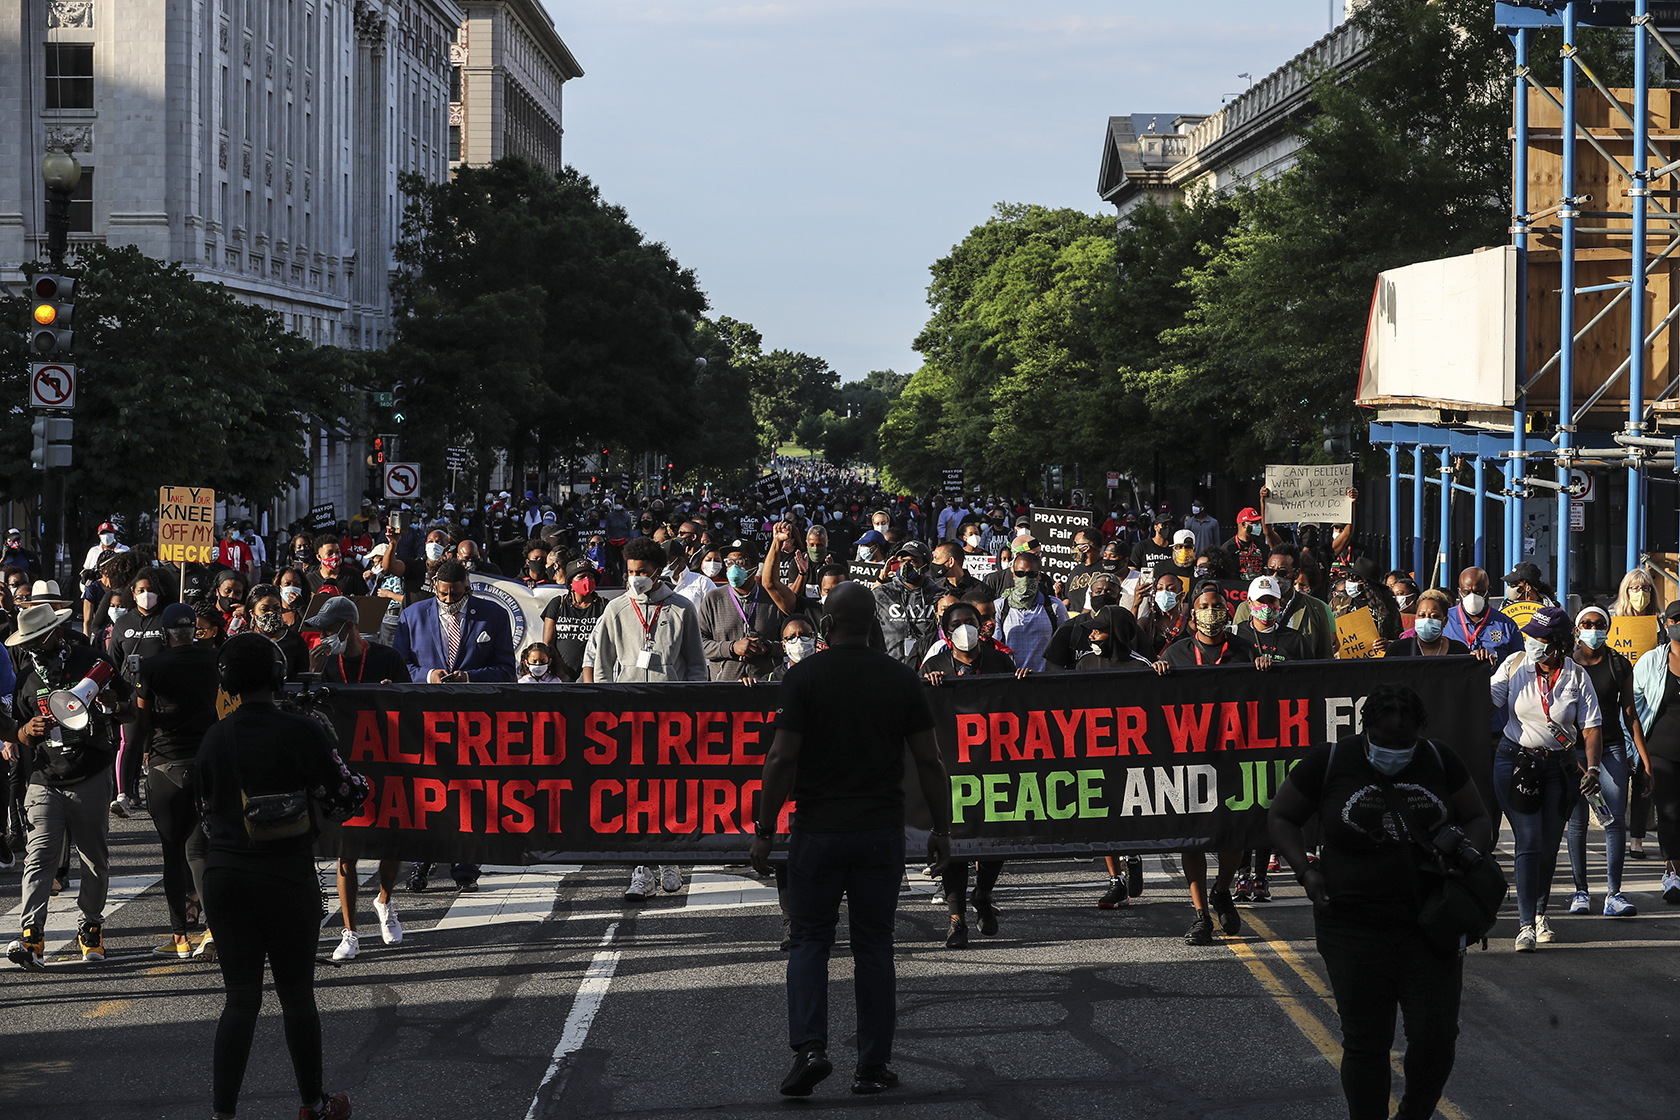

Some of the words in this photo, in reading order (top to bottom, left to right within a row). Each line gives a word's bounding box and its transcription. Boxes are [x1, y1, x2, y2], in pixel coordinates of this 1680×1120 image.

[1313, 466, 1350, 477] BELIEVE
[1271, 478, 1301, 488] WHAT
[1307, 478, 1324, 487] YOU
[1328, 477, 1345, 486] SAY
[189, 488, 211, 505] YOUR
[1271, 488, 1316, 500] BECAUSE
[1320, 487, 1328, 497] I
[1332, 486, 1349, 497] SEE
[312, 506, 324, 514] PRAY
[1280, 500, 1307, 511] WHAT
[1308, 500, 1325, 509] YOU
[161, 503, 212, 523] KNEE
[315, 512, 331, 520] Godly
[1034, 513, 1065, 524] PRAY
[1066, 516, 1089, 527] FOR
[162, 523, 189, 541] OFF
[192, 525, 214, 542] MY
[1049, 528, 1073, 539] Fair
[160, 543, 211, 563] NECK
[1040, 543, 1071, 555] reatm
[850, 565, 878, 576] PRAY
[965, 563, 992, 571] IVES
[483, 586, 520, 613] ADVANCEMENT
[515, 615, 524, 623] OF
[1507, 606, 1519, 615] FOR
[1520, 604, 1532, 612] THE
[580, 616, 597, 626] QUI
[555, 624, 579, 632] WON'T
[1339, 626, 1344, 635] I
[1616, 626, 1620, 636] I
[1342, 633, 1358, 646] AM
[1613, 639, 1632, 648] AM
[1344, 642, 1366, 655] THE
[1617, 651, 1637, 660] HE
[350, 710, 567, 766] ALFRED
[583, 711, 777, 766] STREE
[956, 706, 1152, 763] PRAYER
[1160, 698, 1311, 754] WALK
[950, 768, 1109, 824] PEACE
[1120, 763, 1219, 817] AND
